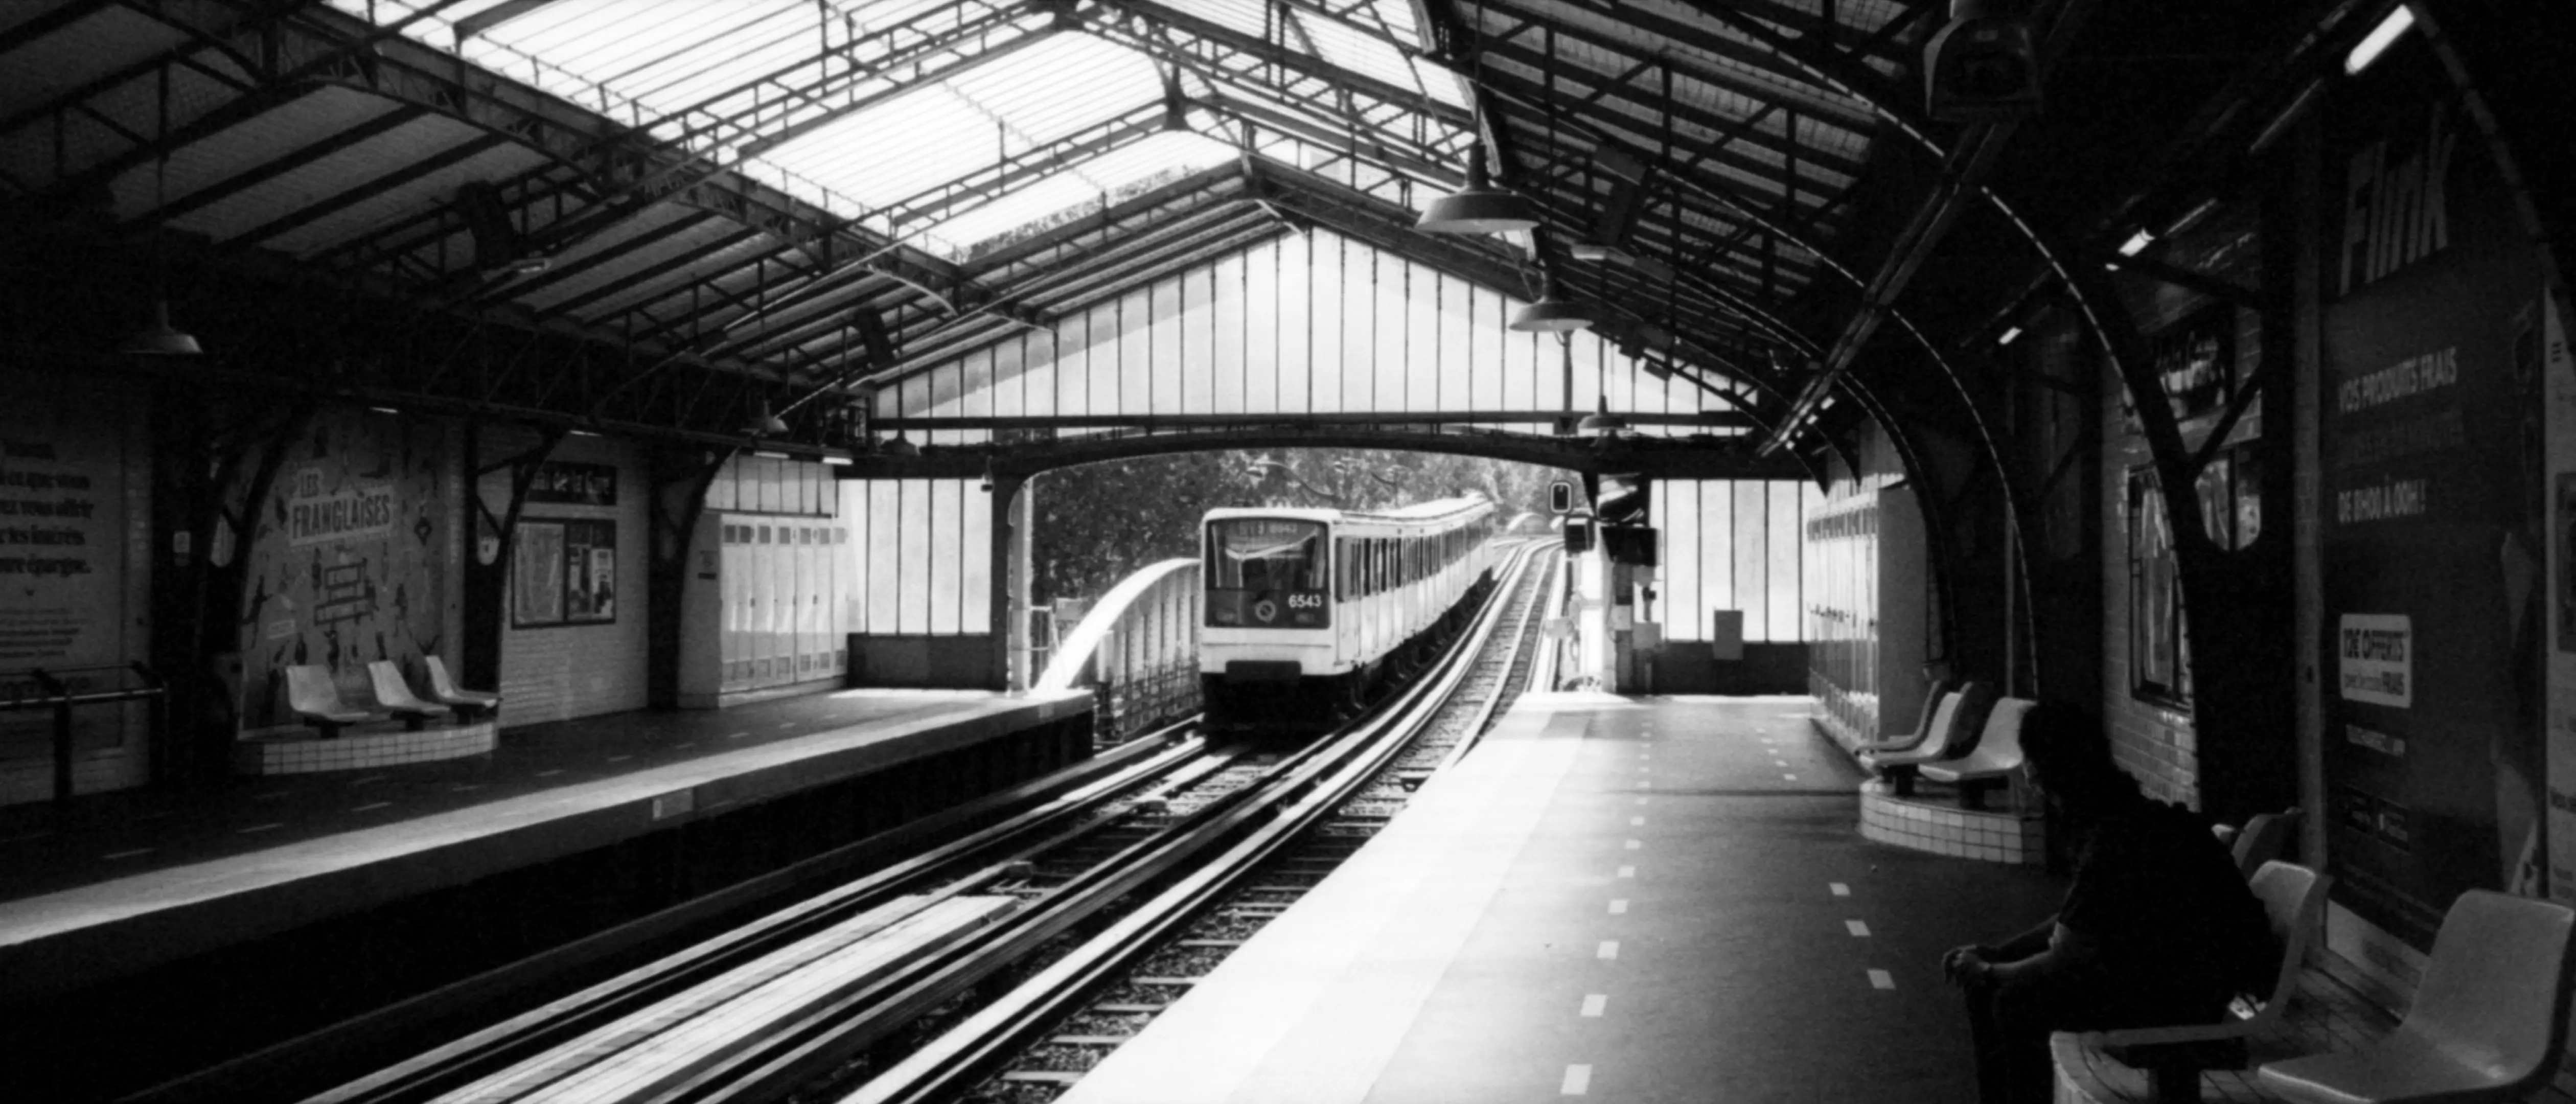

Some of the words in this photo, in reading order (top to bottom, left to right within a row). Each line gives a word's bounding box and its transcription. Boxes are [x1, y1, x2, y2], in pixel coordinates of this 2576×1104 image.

[2362, 357, 2419, 407] PRODUITS
[2421, 346, 2457, 391] FRAIS
[56, 473, 90, 490] vous
[301, 473, 319, 498] LES
[2338, 489, 2352, 523] DE
[1288, 594, 1322, 608] 6543
